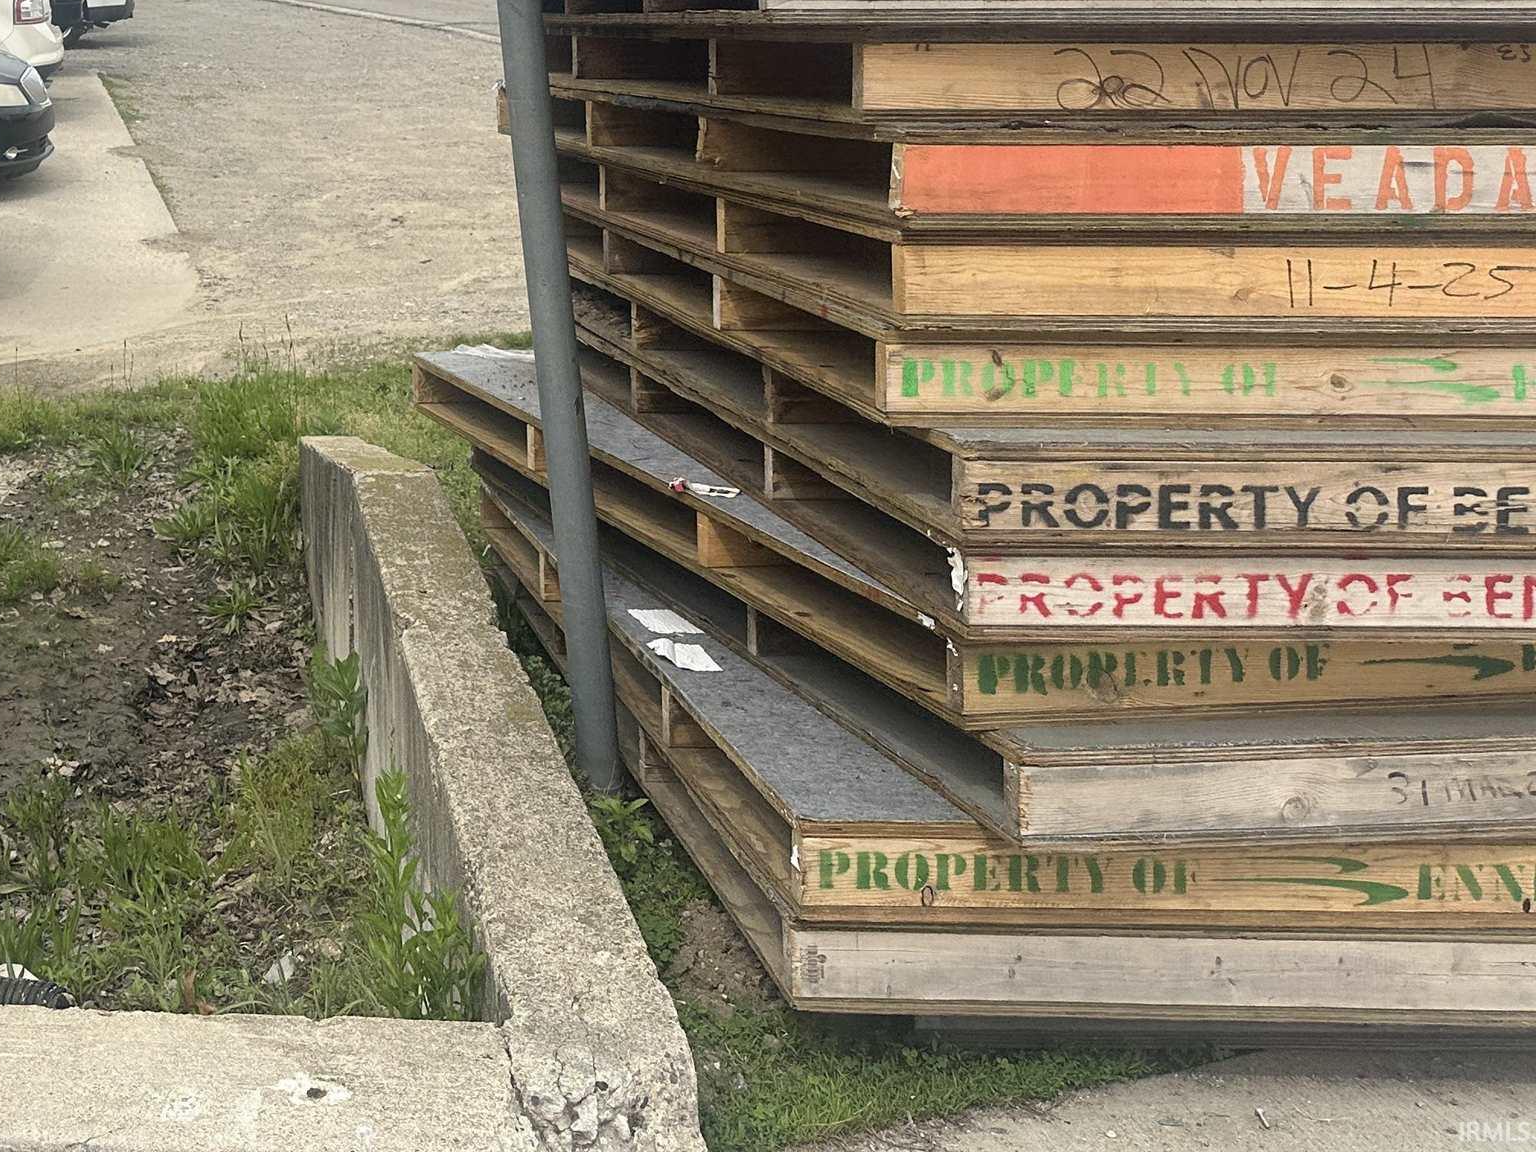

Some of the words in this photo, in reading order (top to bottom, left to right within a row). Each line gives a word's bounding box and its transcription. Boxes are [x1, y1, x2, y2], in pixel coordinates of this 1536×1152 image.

[1327, 44, 1437, 110] 24
[977, 482, 1323, 530] PROPERTY
[1345, 485, 1429, 532] OF
[975, 572, 1314, 620] PROPERTY
[1336, 572, 1414, 618] OF
[977, 647, 1250, 695] PROPERTY
[1269, 643, 1331, 682] OF
[818, 848, 1114, 894] PROPERTY
